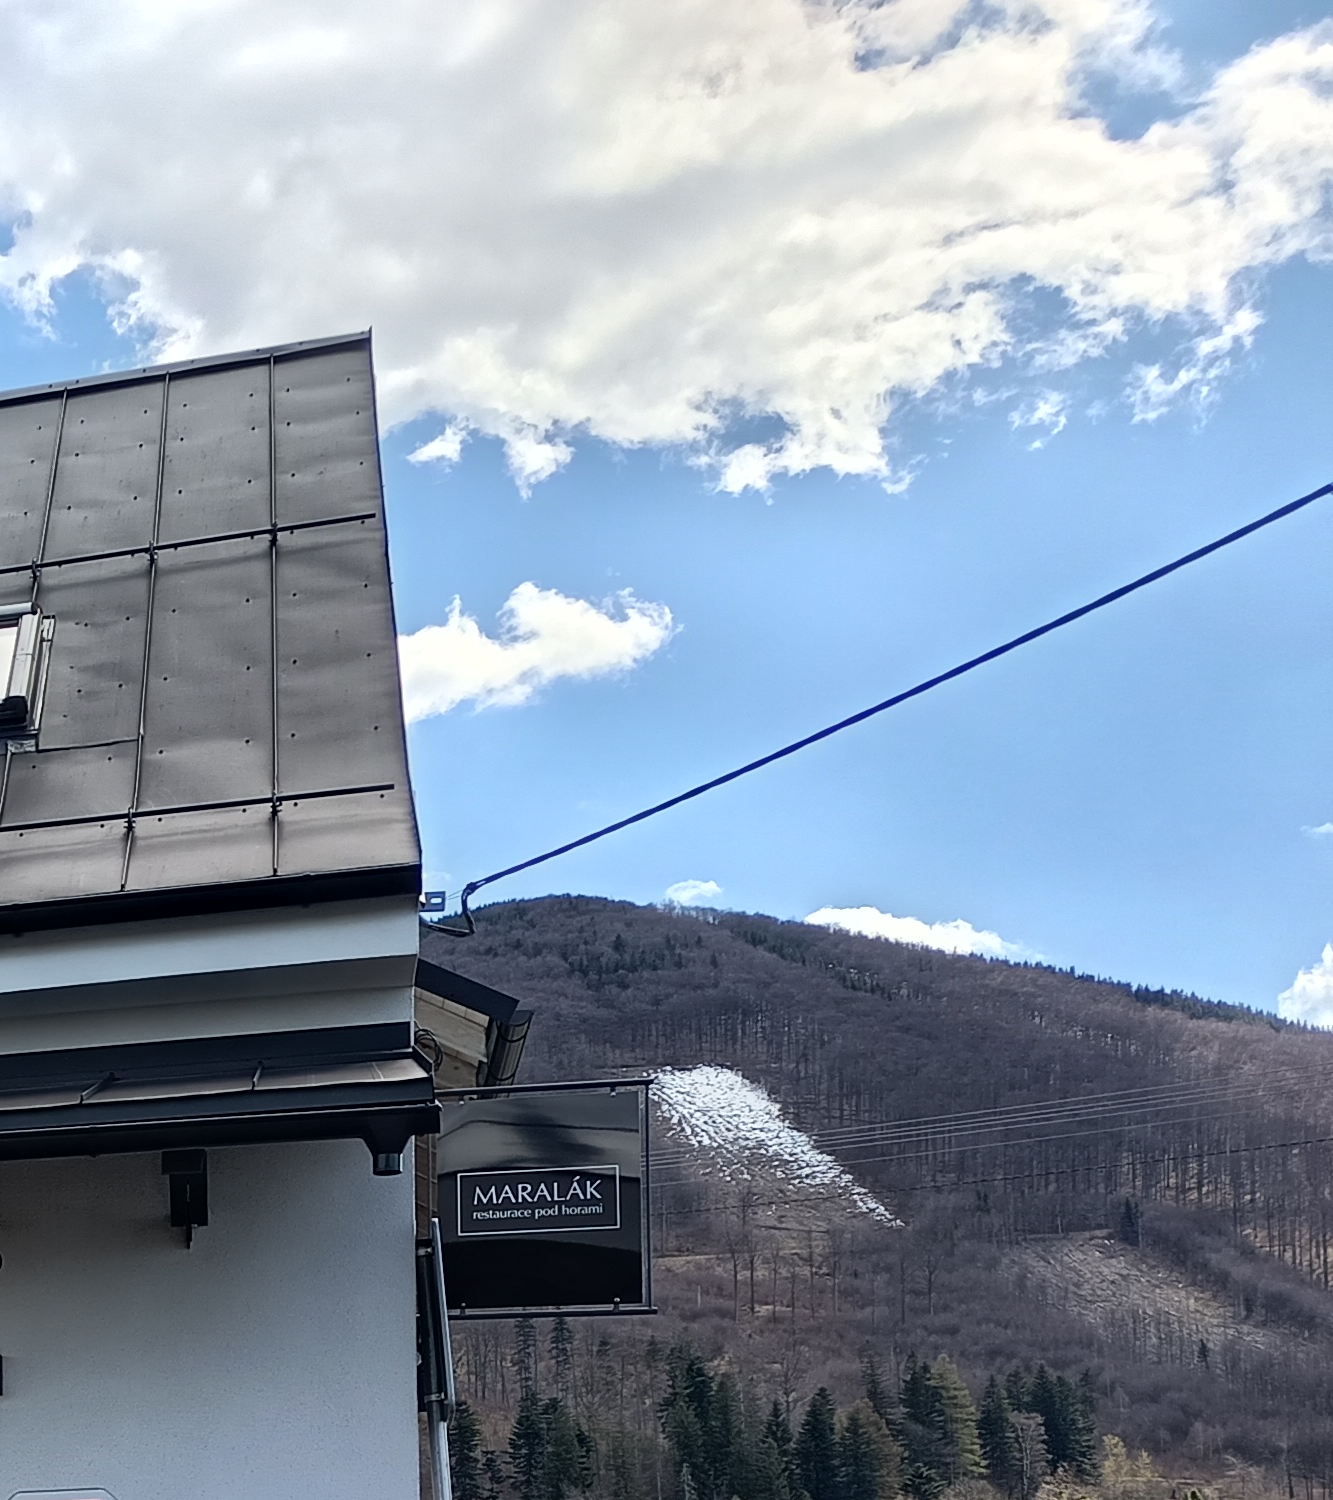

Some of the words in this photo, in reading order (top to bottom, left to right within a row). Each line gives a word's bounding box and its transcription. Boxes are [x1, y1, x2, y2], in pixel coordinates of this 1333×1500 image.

[473, 1175, 603, 1206] MARALÁK
[472, 1208, 532, 1220] restaurace
[535, 1204, 559, 1220] pod
[562, 1202, 604, 1216] horami
